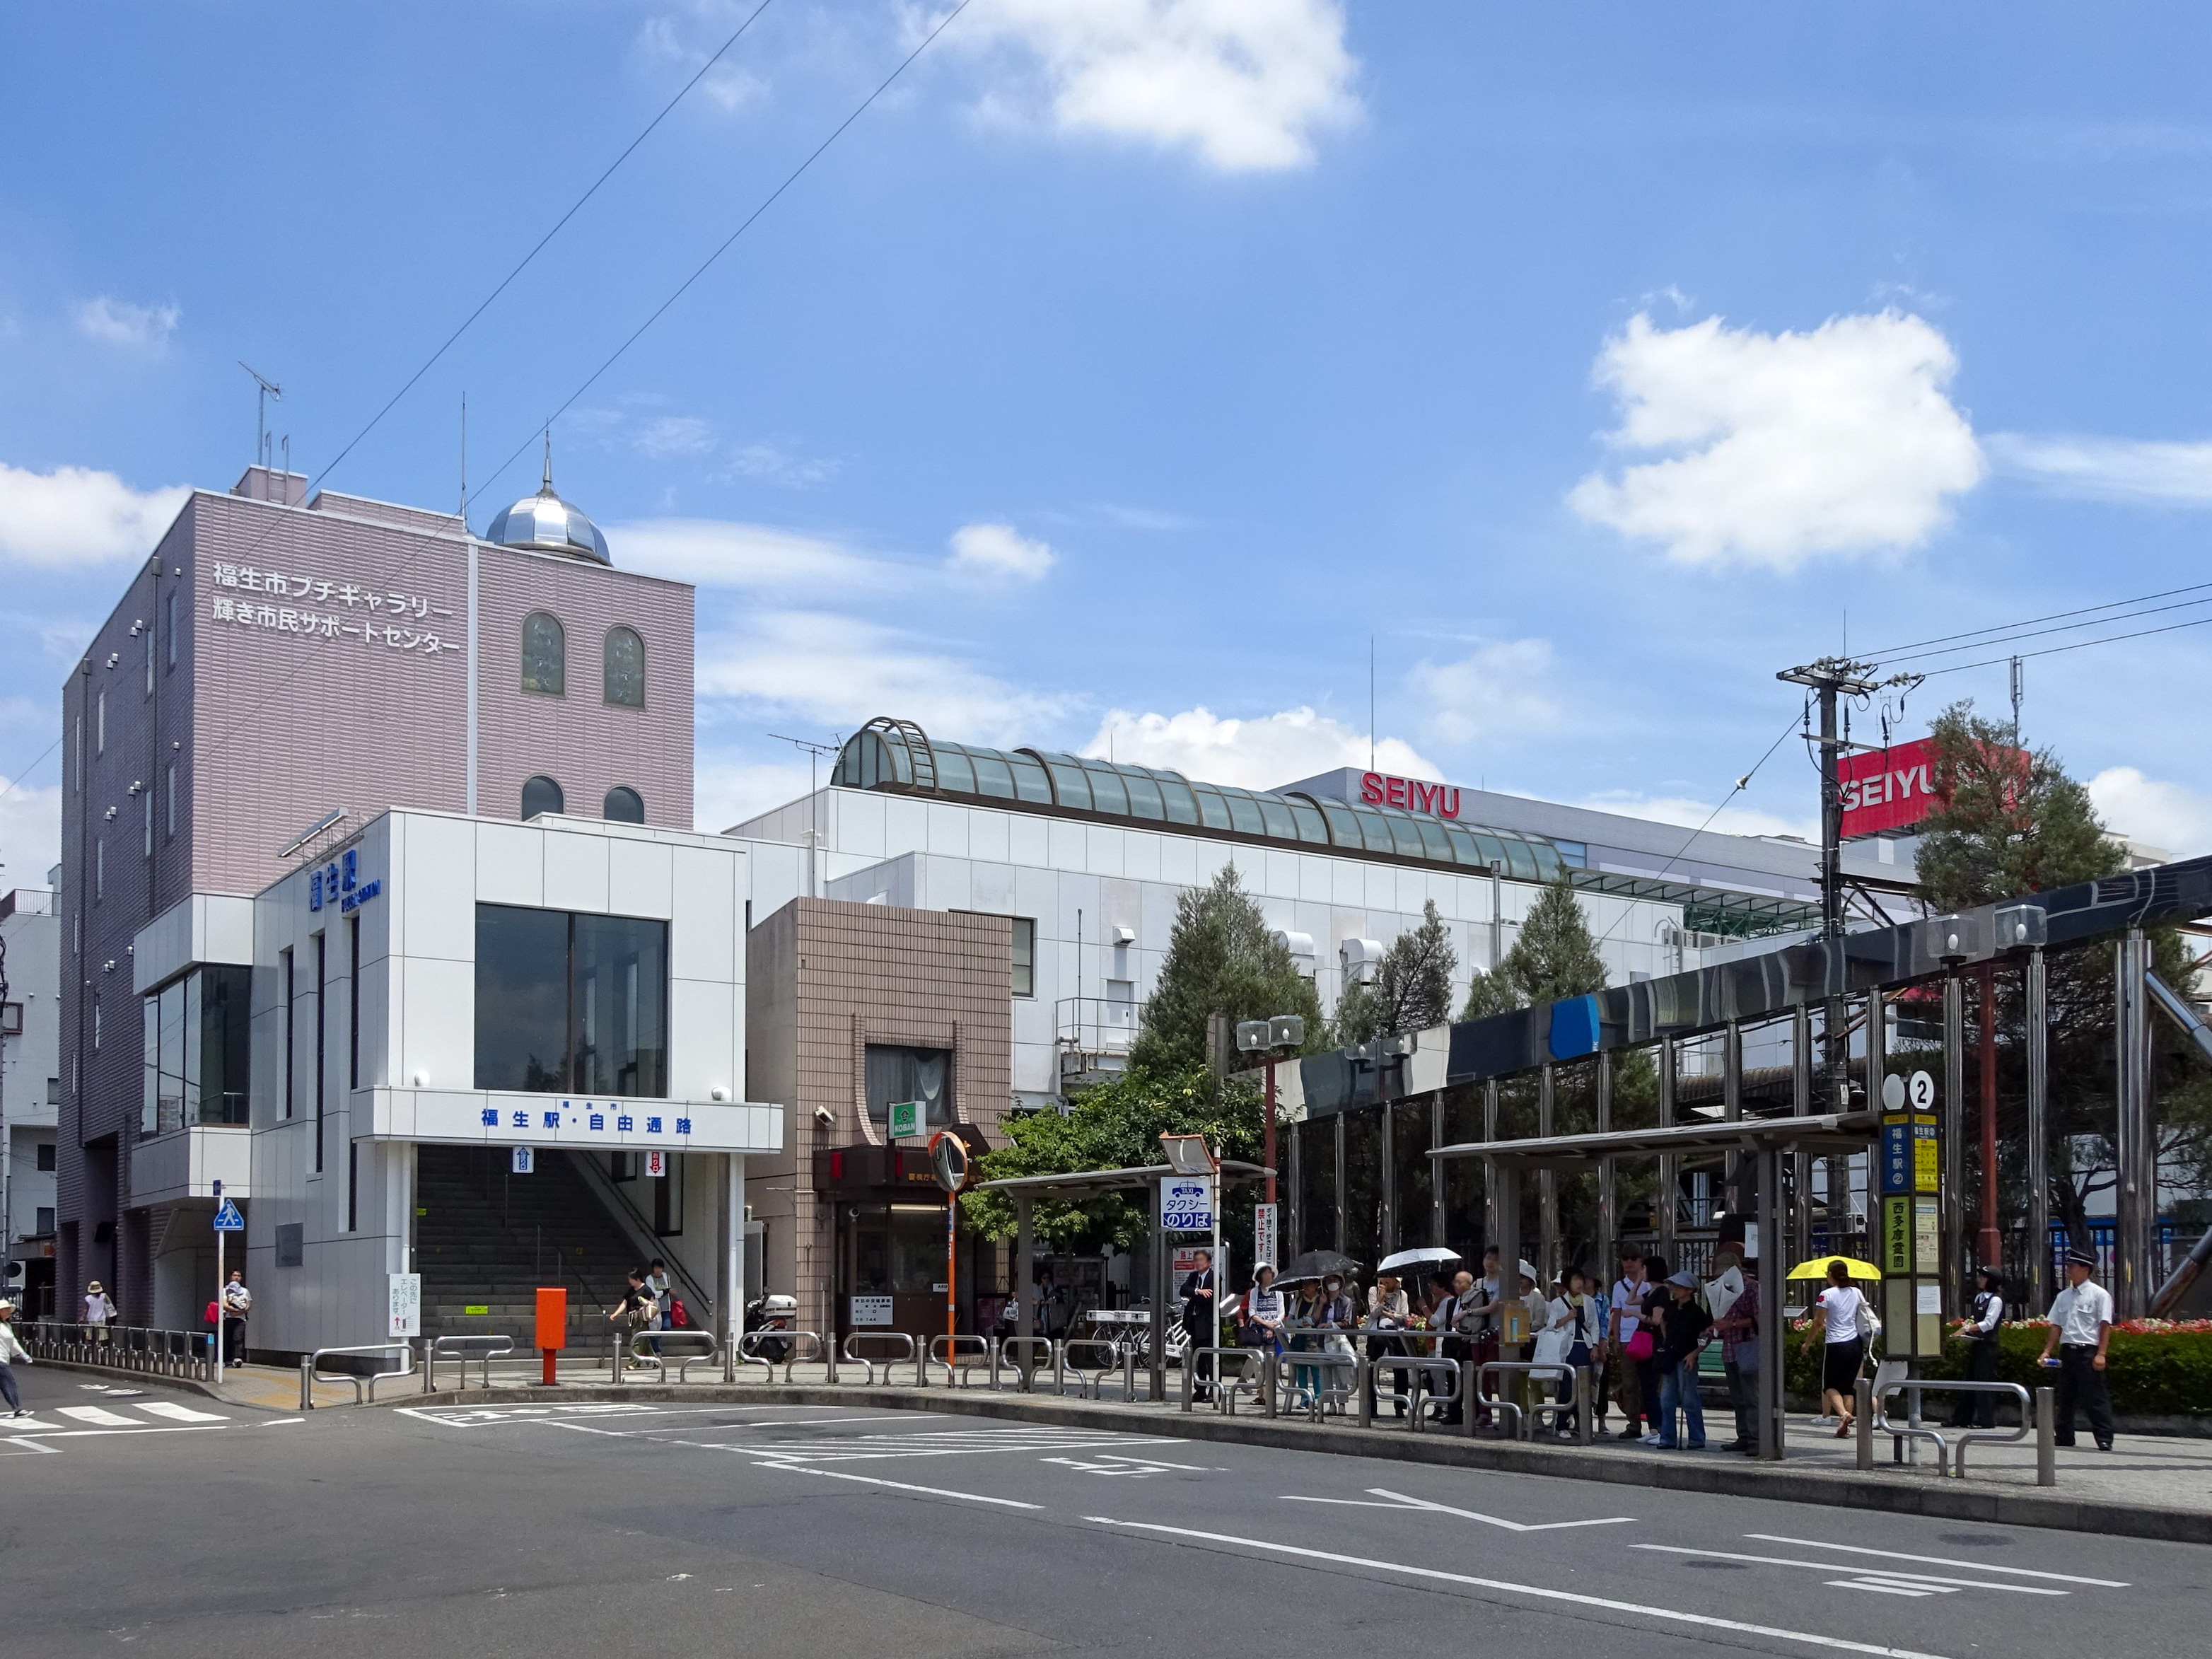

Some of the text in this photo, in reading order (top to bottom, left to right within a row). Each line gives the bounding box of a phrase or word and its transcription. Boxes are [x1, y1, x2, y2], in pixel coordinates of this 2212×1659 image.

[213, 563, 453, 618] 福生市プチギャラリー
[212, 598, 460, 653] 輝き市民サポートセンター
[1361, 772, 1460, 819] SEIYU
[1839, 764, 1940, 812] SEIYU
[1917, 1080, 1927, 1104] 2
[482, 1108, 691, 1134] 福生駅・自由通路
[895, 1122, 915, 1132] KOBAN
[1166, 1199, 1208, 1211] タクシー
[1167, 1213, 1209, 1227] のりば
